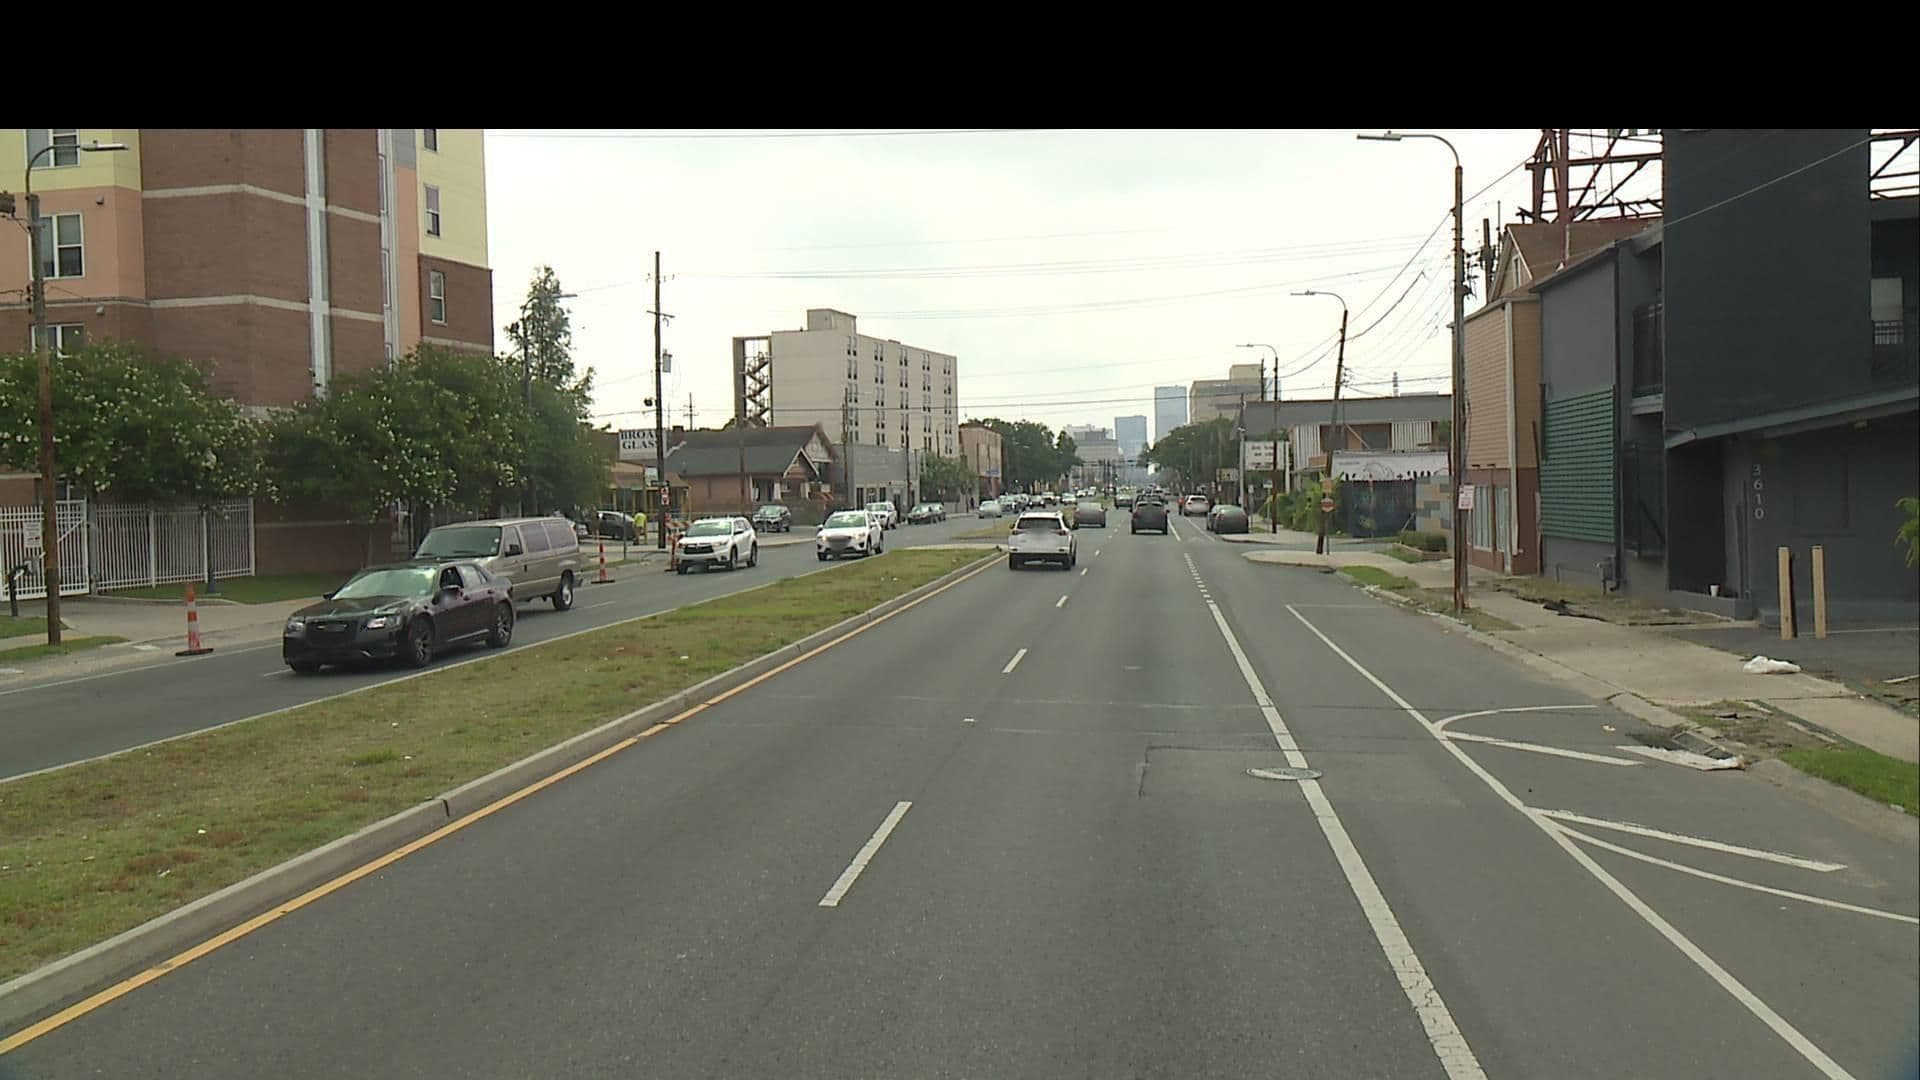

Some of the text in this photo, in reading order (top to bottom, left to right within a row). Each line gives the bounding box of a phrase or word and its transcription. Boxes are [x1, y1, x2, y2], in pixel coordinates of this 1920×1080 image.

[620, 431, 659, 440] BROA
[622, 440, 659, 450] GLAS
[1751, 463, 1765, 520] 3610
